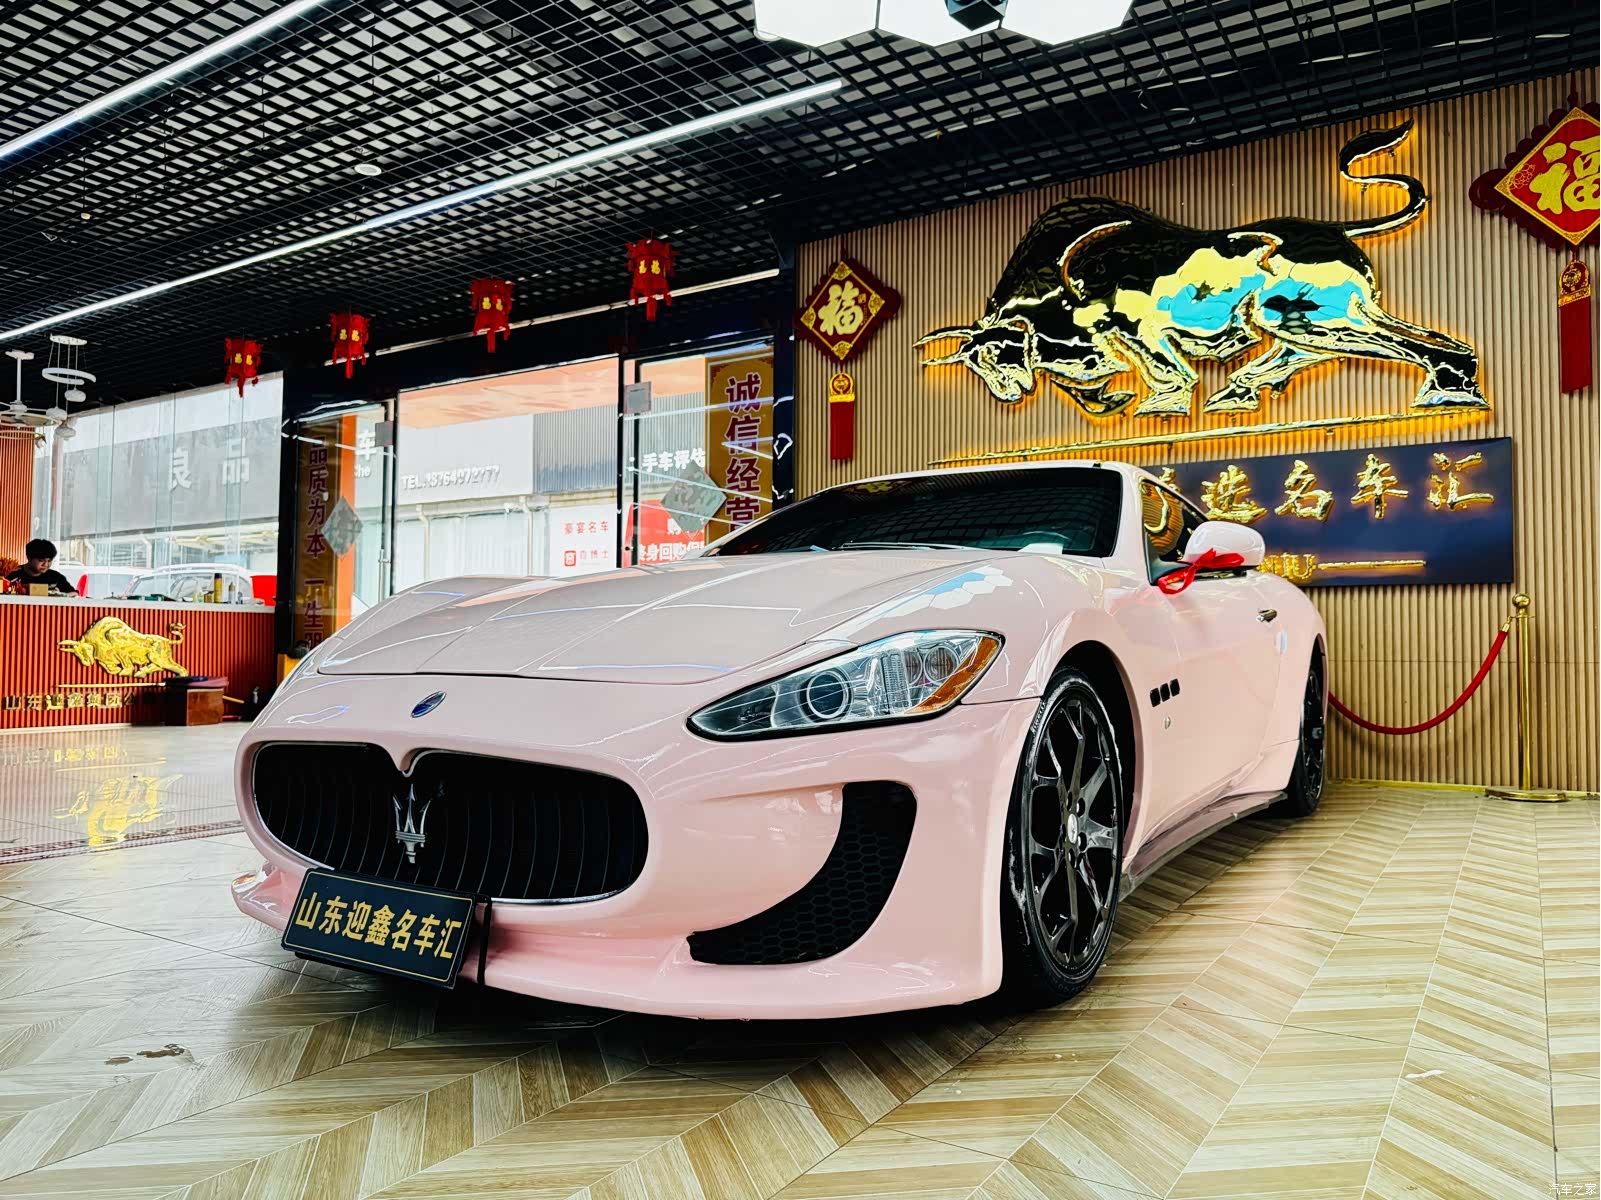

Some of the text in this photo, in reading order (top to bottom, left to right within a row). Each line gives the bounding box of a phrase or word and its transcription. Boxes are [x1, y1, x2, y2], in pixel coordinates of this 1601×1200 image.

[1529, 135, 1600, 214] 福
[818, 281, 864, 336] 福
[725, 373, 762, 531] 诚信经营
[306, 436, 328, 559] 品质为本
[295, 891, 462, 959] 山东迎鑫名车汇
